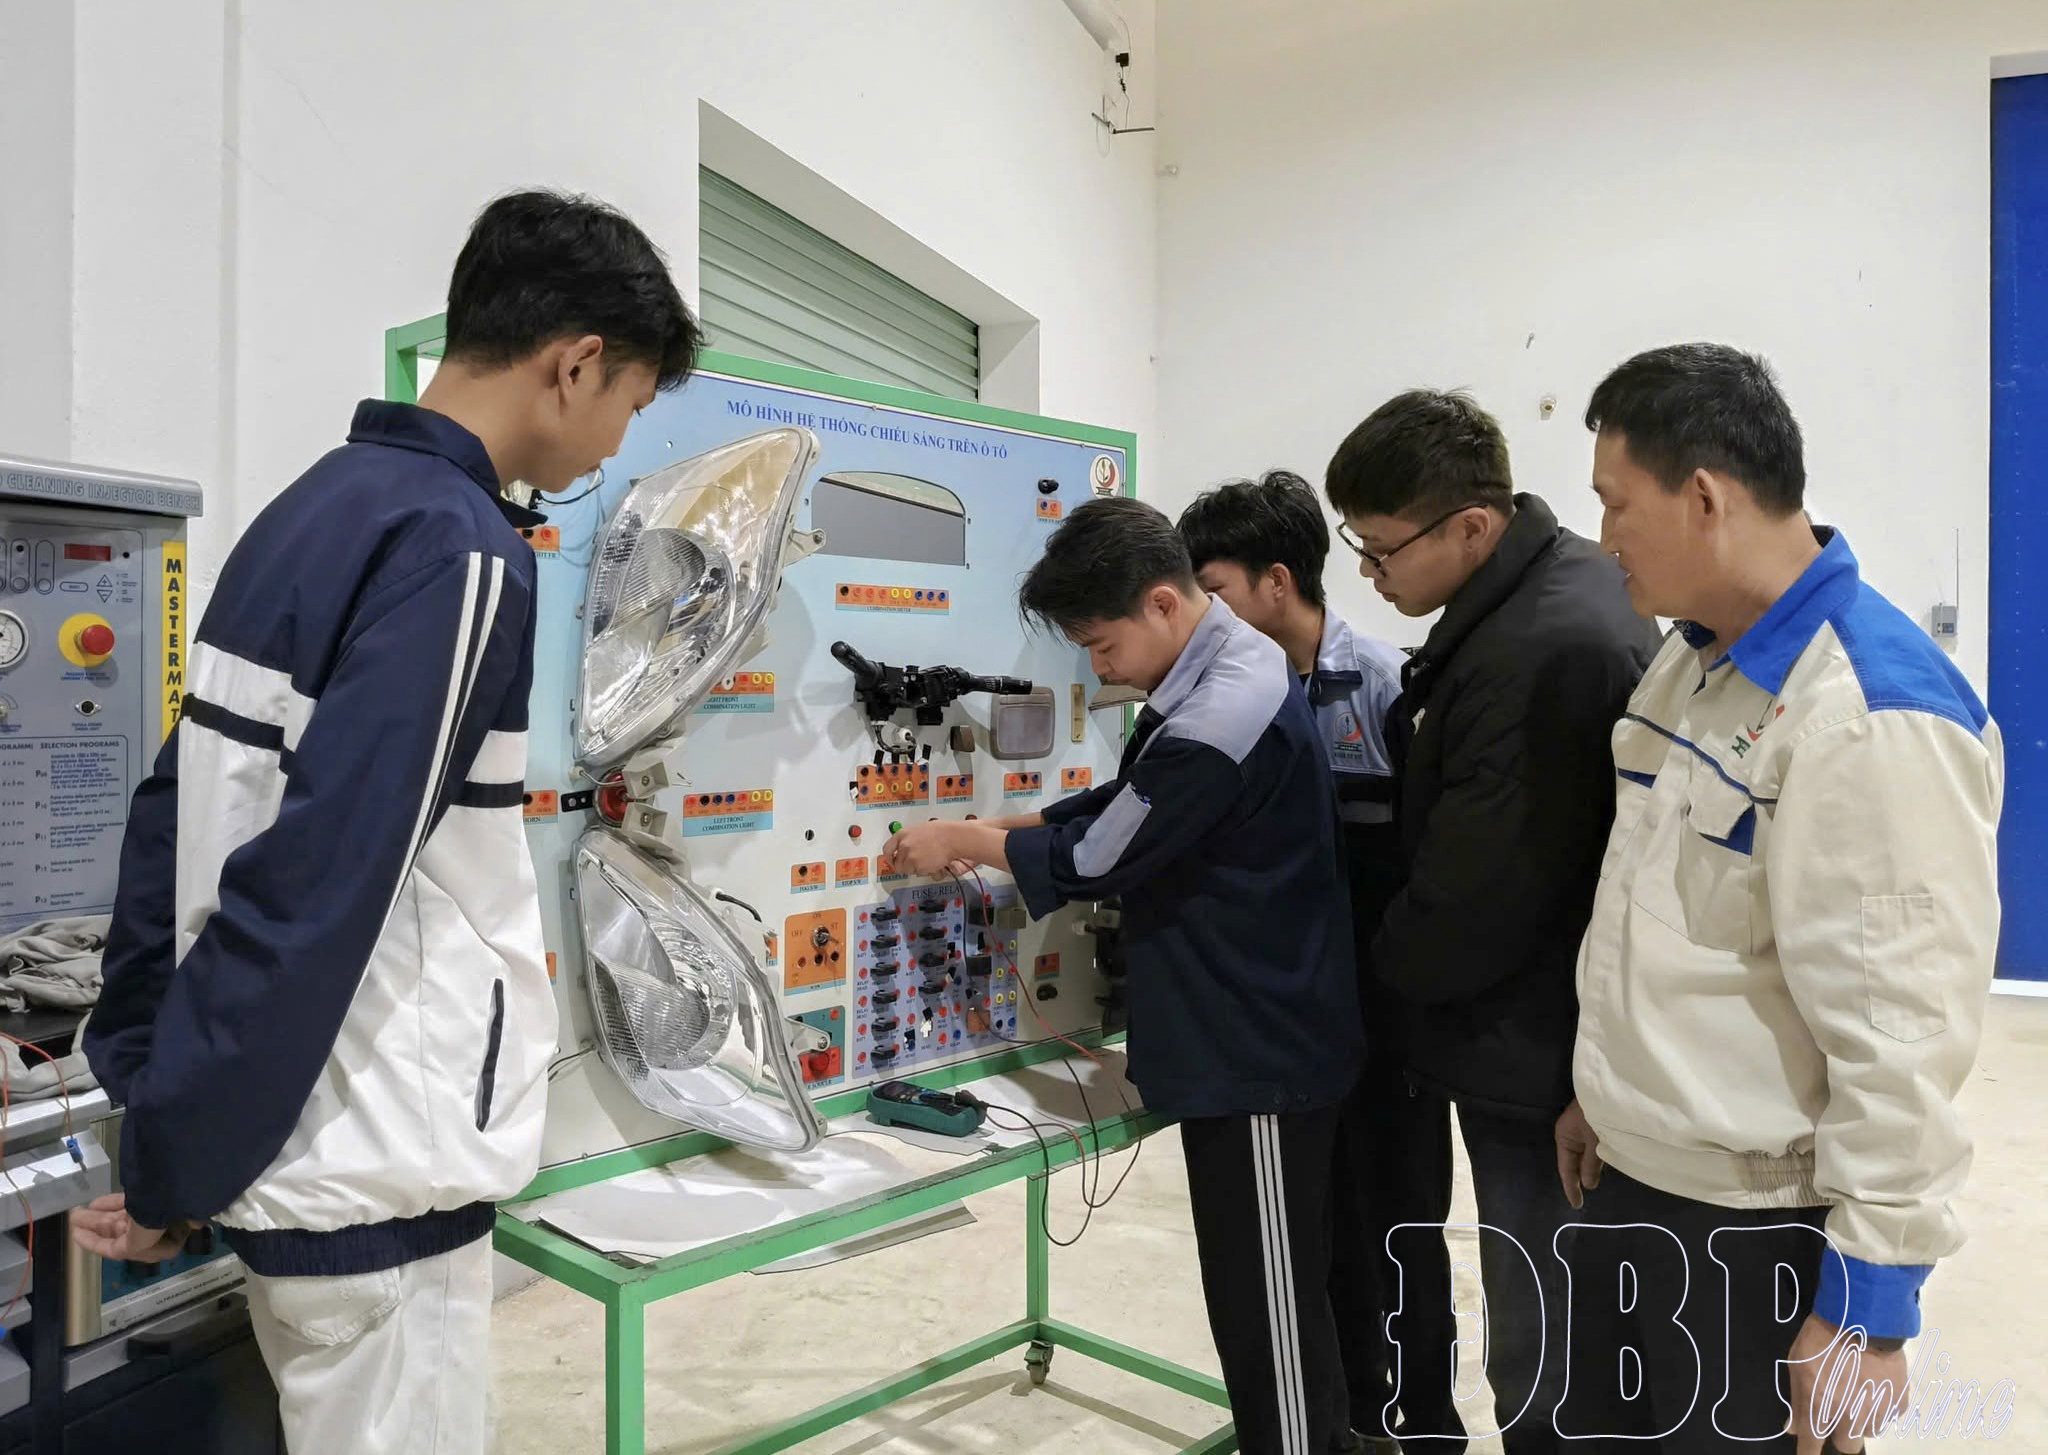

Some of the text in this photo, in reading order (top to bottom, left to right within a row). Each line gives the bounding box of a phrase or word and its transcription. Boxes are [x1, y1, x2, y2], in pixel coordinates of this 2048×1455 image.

[727, 399, 752, 417] MÔ
[797, 412, 816, 431] HỆ
[913, 431, 945, 449] SÁNG
[947, 438, 979, 454] TRÊN
[992, 444, 1008, 459] TÔ
[7, 473, 84, 497] CLEANING
[88, 482, 155, 506] INJECTOR
[157, 491, 201, 511] BENCH
[166, 558, 183, 723] MASTERMAT
[40, 741, 78, 750] SELECTION
[79, 740, 120, 749] PROGRAMS
